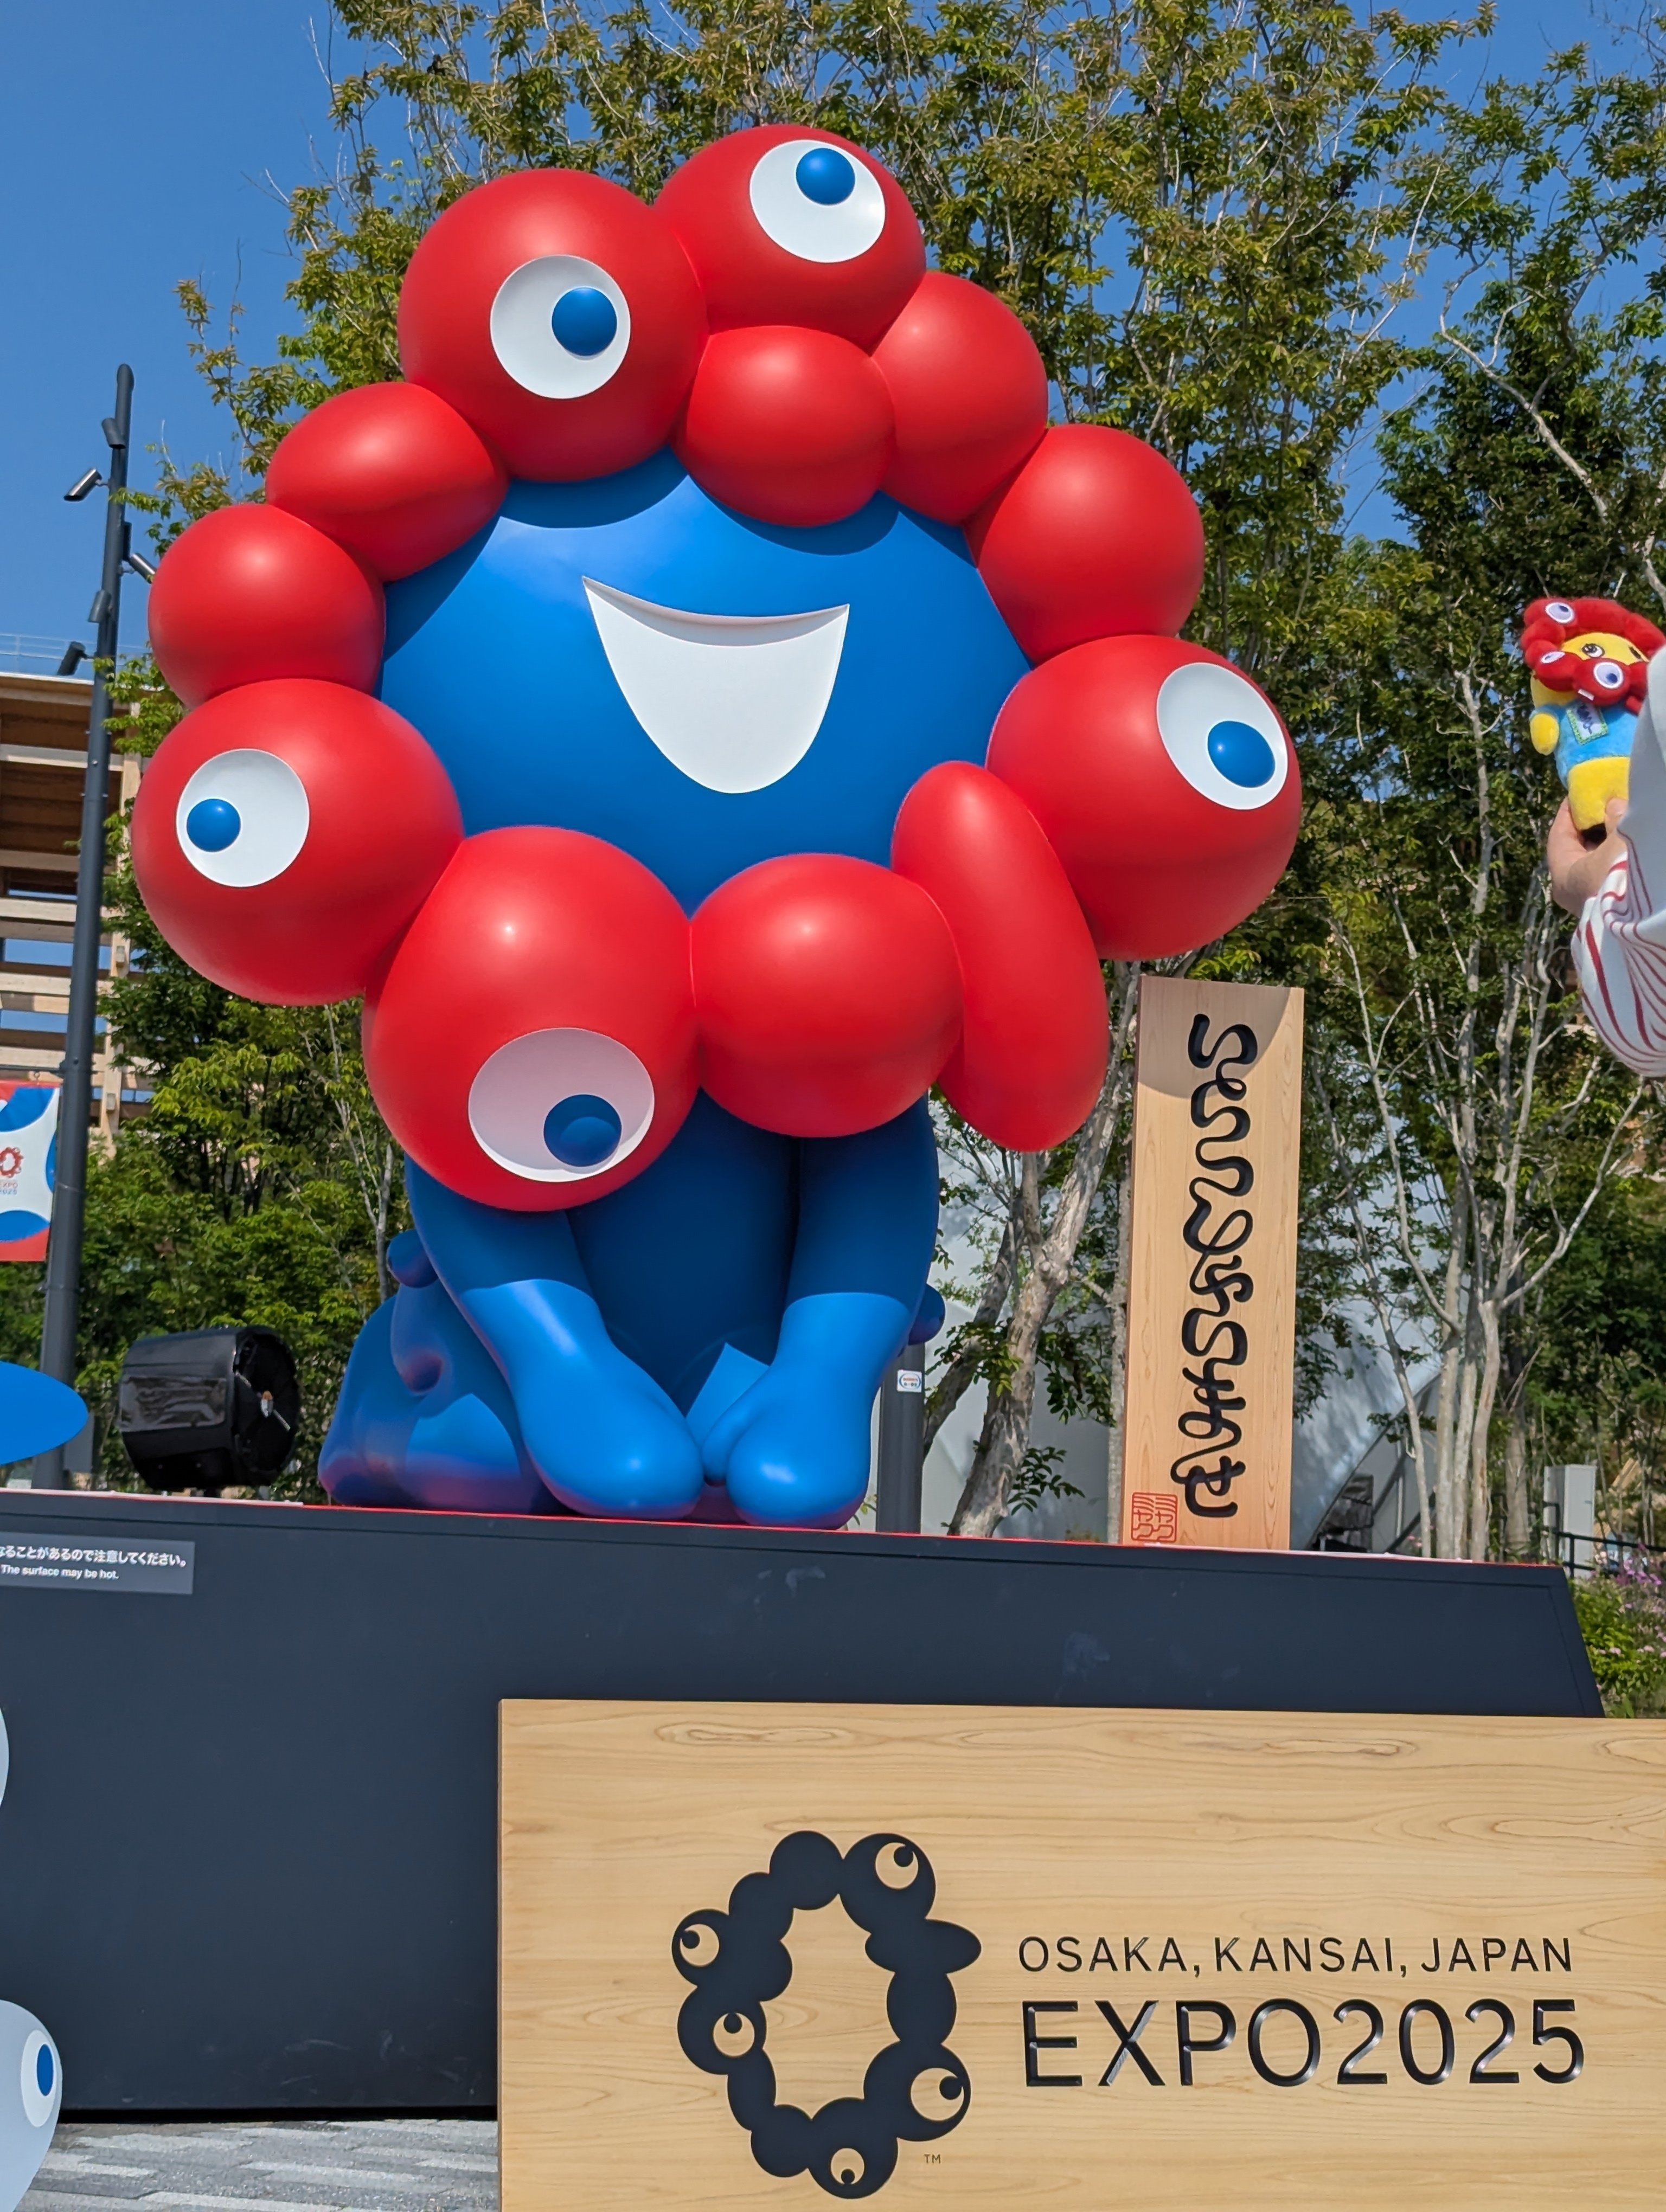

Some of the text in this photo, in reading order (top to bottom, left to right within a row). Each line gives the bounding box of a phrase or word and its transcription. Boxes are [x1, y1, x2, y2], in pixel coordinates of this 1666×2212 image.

[1, 1564, 119, 1580] The surface may be hot.
[1018, 1936, 1572, 1978] OSAKA, KANSAI, JAPAN
[1022, 1997, 1584, 2088] EXPO2025
[924, 2153, 941, 2164] TM
